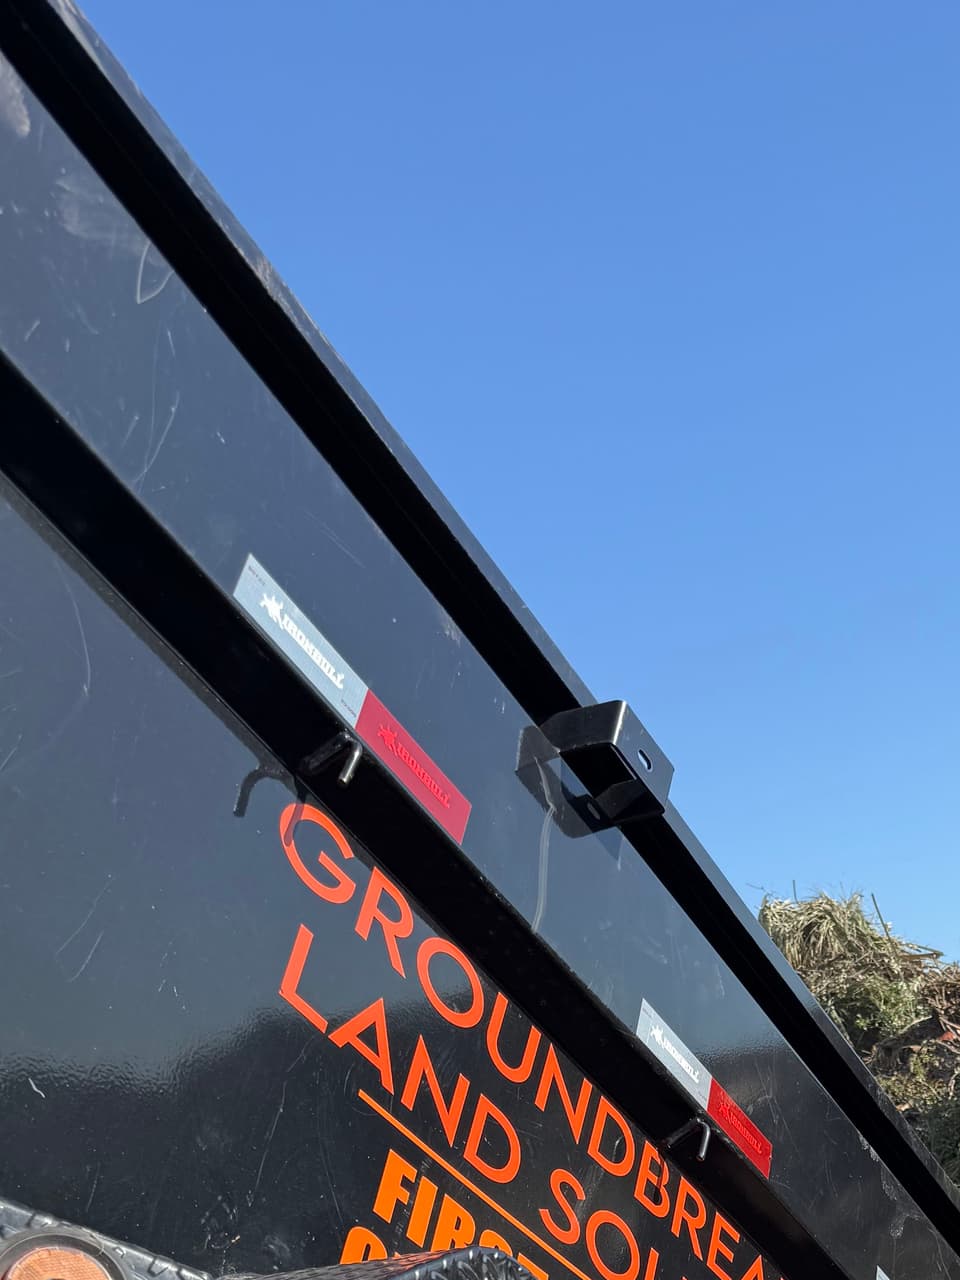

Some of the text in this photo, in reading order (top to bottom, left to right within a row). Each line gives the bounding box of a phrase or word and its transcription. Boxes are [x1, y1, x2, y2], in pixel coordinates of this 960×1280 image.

[282, 613, 346, 689] IRONBULL
[396, 741, 451, 809] IRONBULL
[279, 923, 521, 1184] LAND
